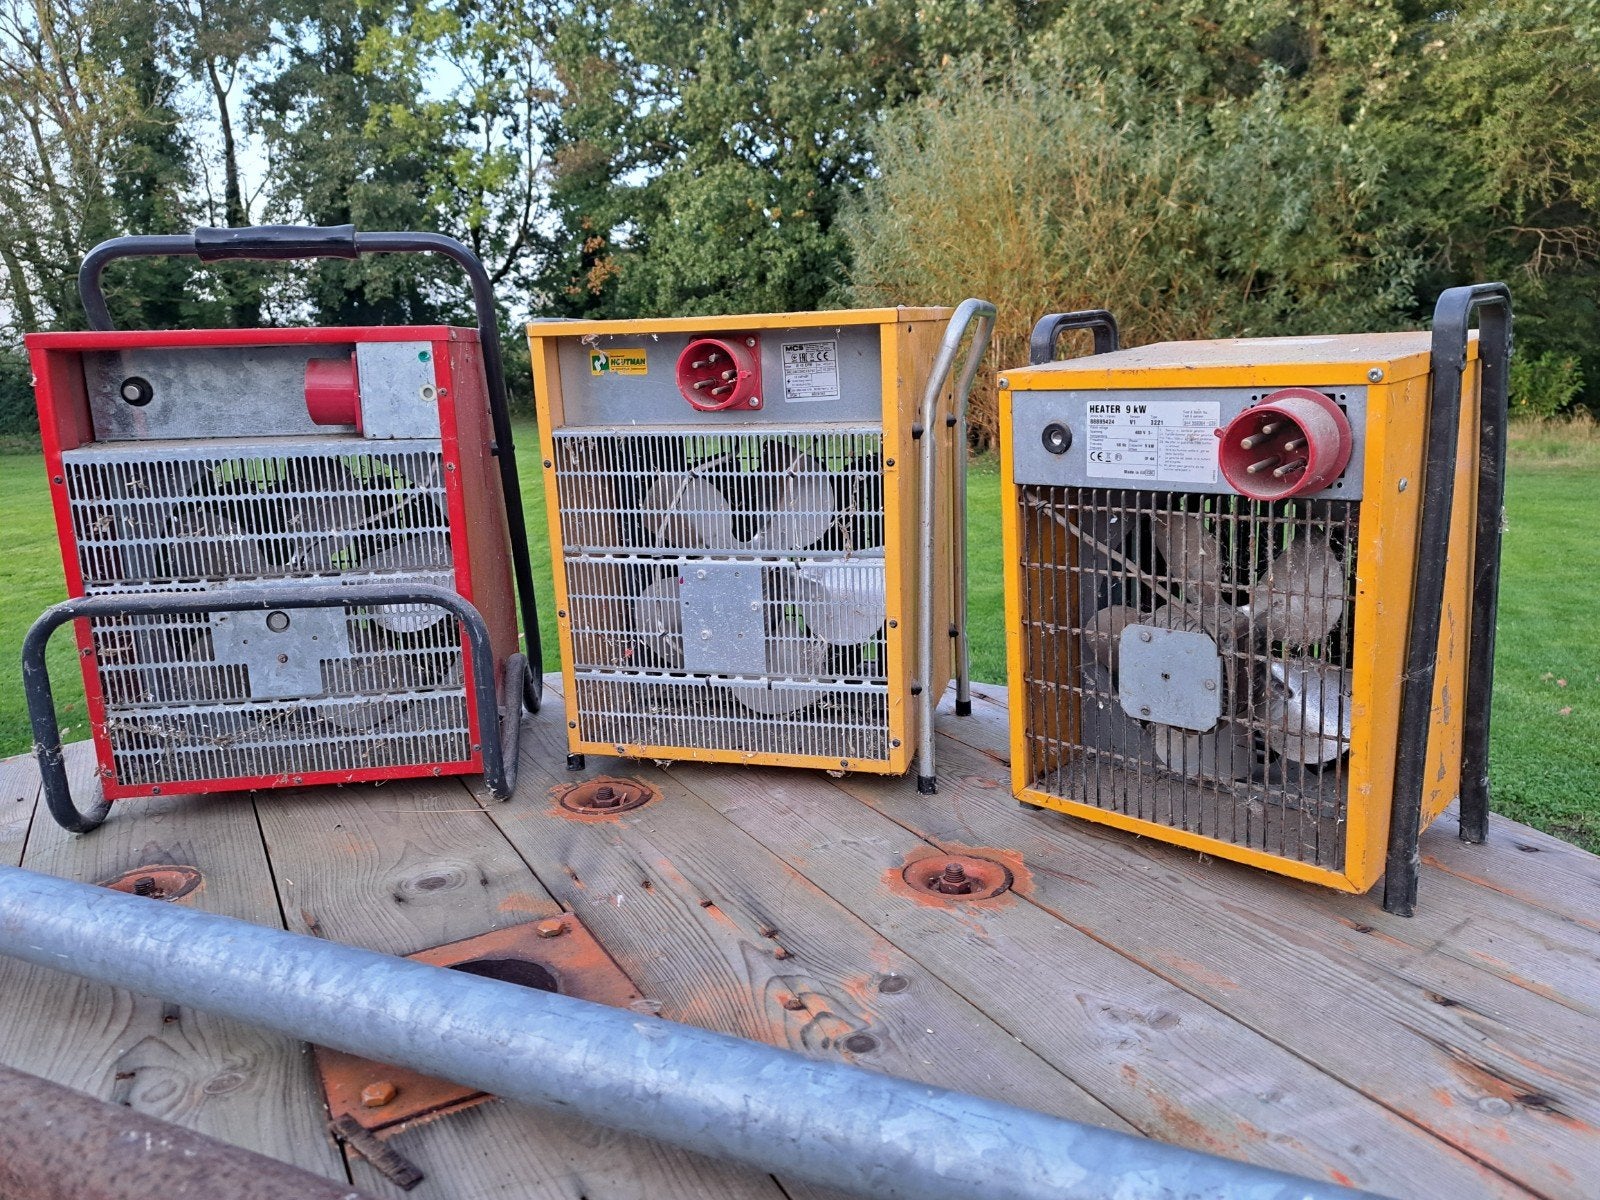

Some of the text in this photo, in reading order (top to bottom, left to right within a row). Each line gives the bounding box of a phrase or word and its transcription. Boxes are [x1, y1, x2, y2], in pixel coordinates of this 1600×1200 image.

[1089, 404, 1147, 414] HEATER 9 kW
